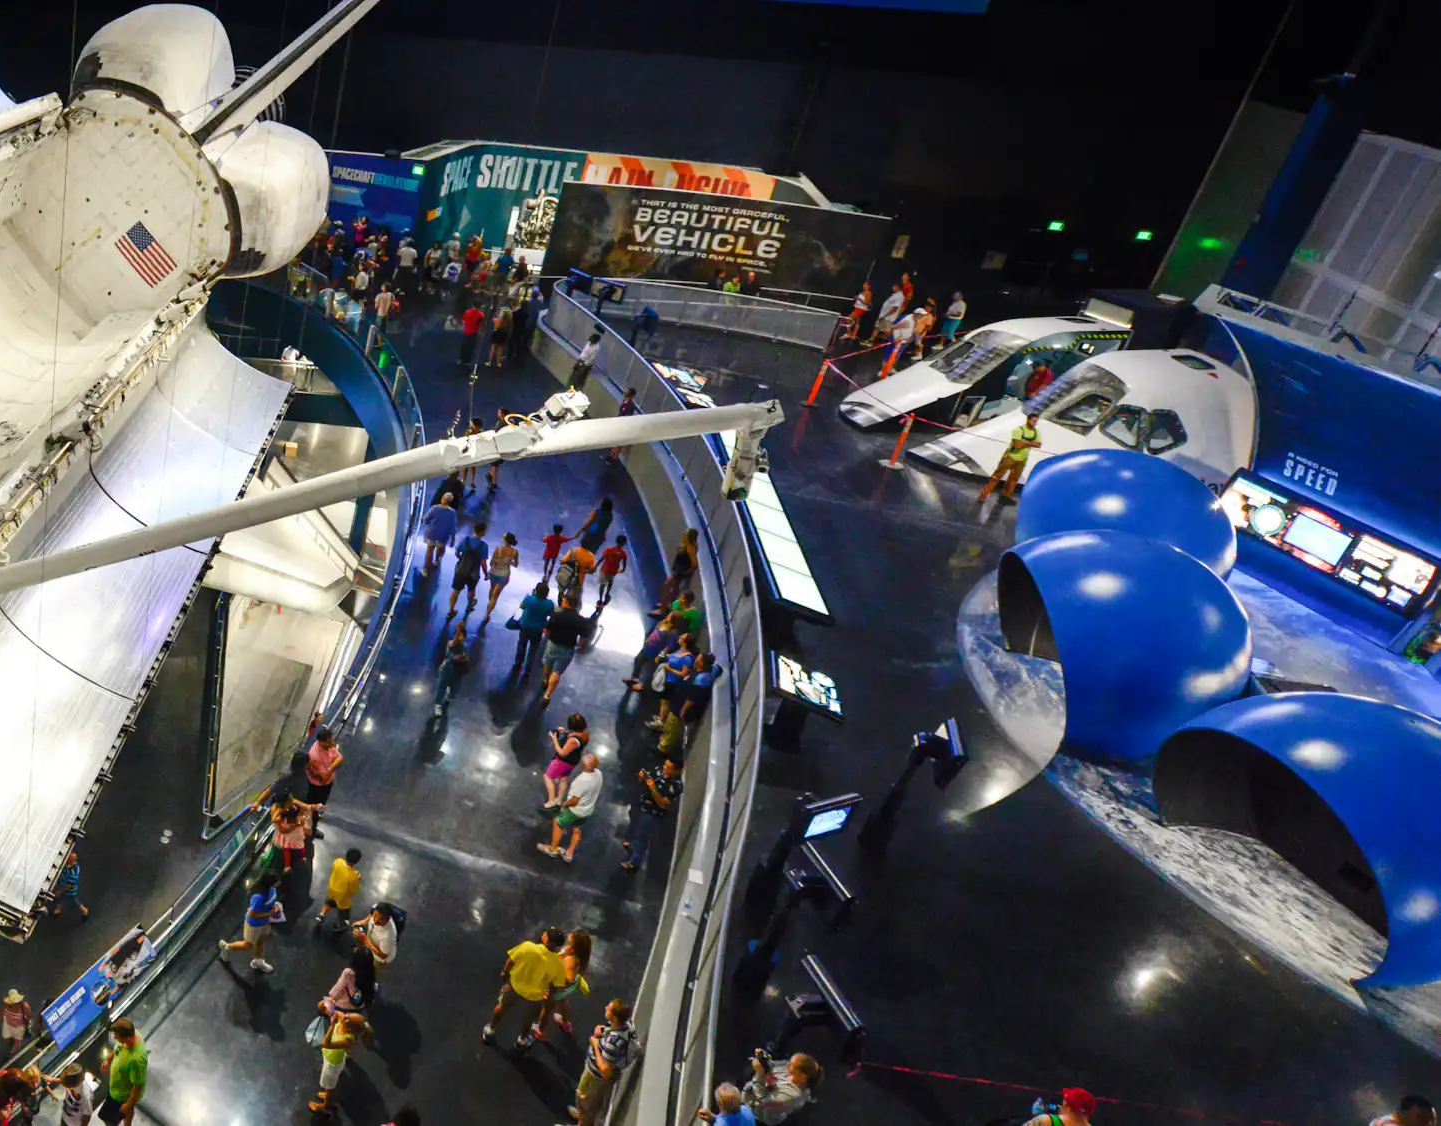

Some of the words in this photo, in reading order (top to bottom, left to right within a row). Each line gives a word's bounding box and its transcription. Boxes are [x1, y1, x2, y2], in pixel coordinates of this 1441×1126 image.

[439, 155, 474, 197] SPACE
[476, 153, 578, 195] SHUTTLE
[635, 207, 787, 239] BEAUTIFUL
[680, 202, 700, 210] THE
[702, 205, 731, 214] MOST
[633, 224, 782, 259] VEHICLE
[1283, 459, 1338, 496] SPEED
